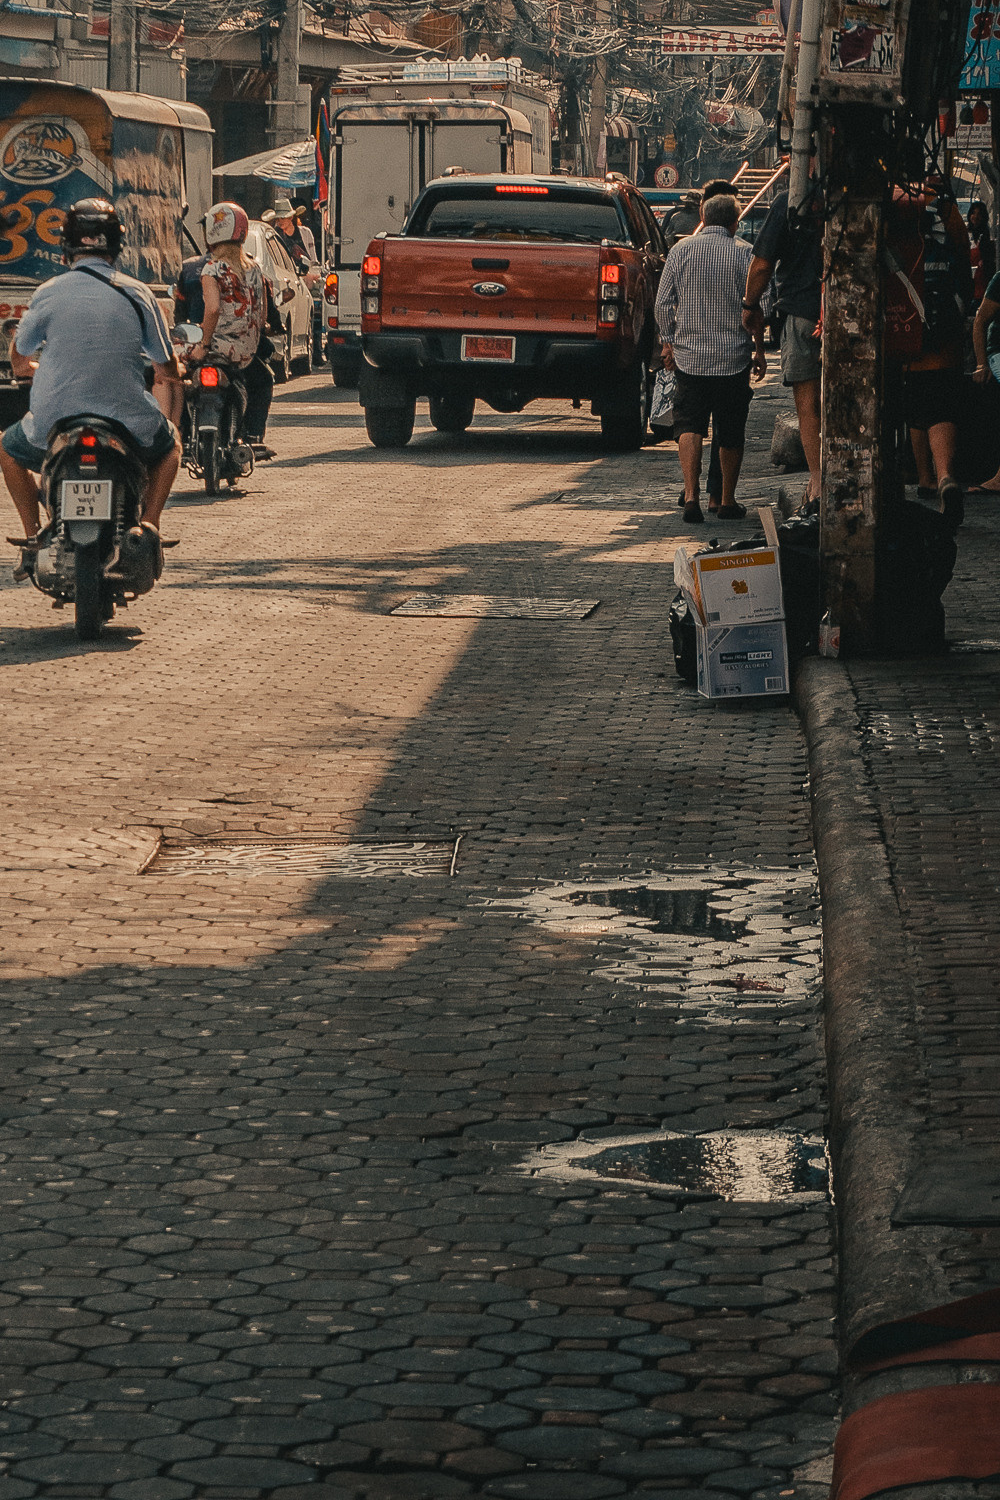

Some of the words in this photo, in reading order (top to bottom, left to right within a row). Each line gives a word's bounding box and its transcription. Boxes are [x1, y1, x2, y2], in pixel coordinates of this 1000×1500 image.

[479, 284, 500, 294] Ford
[719, 556, 755, 567] SINGHA
[748, 652, 772, 660] LIGHT
